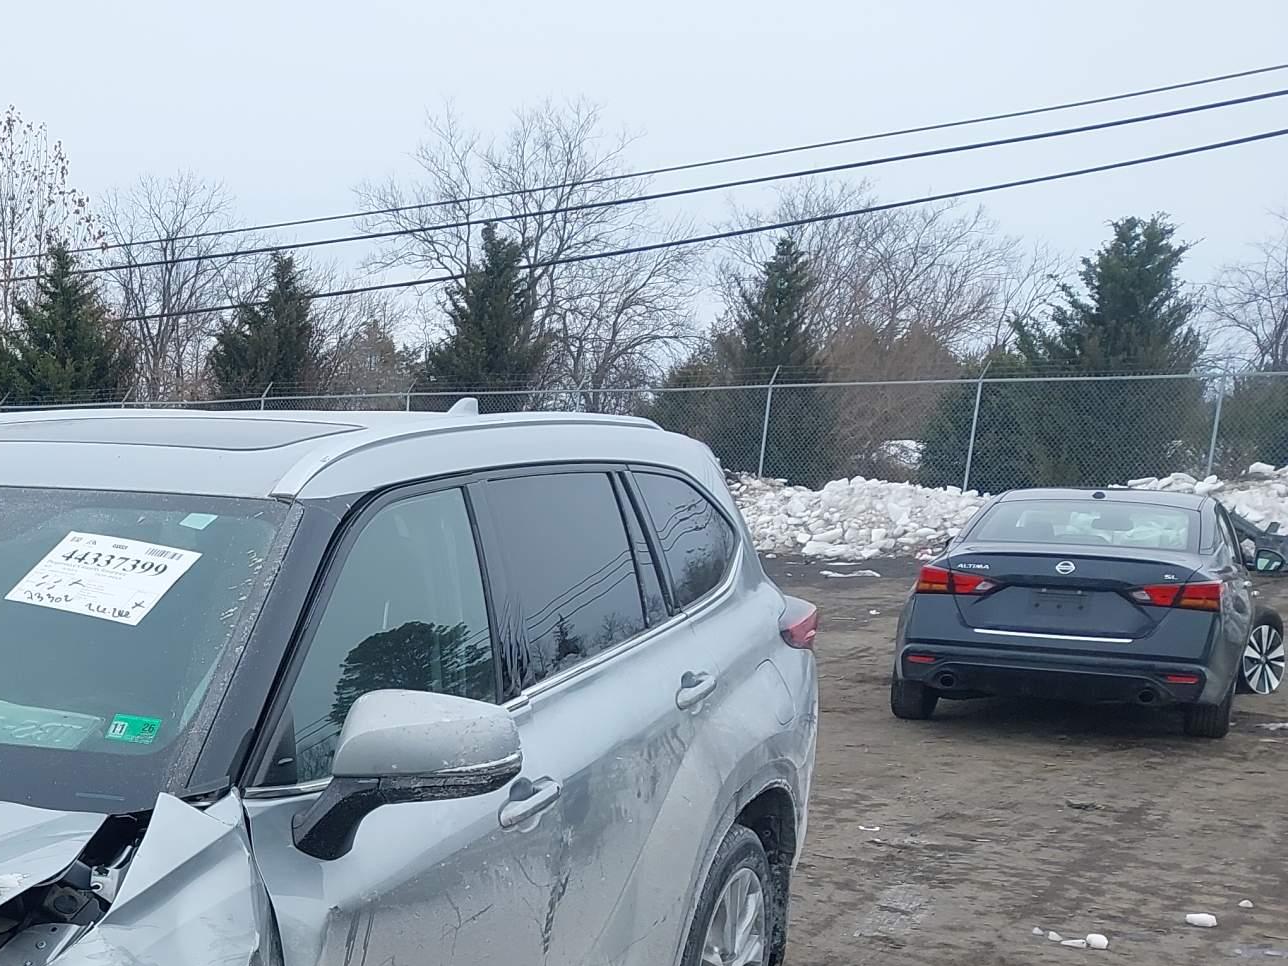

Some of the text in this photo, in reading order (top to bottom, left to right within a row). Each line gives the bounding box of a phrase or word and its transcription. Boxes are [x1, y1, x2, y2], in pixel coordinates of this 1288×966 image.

[62, 549, 168, 577] 44337399
[957, 562, 990, 570] ALTIMA
[141, 722, 157, 733] 26
